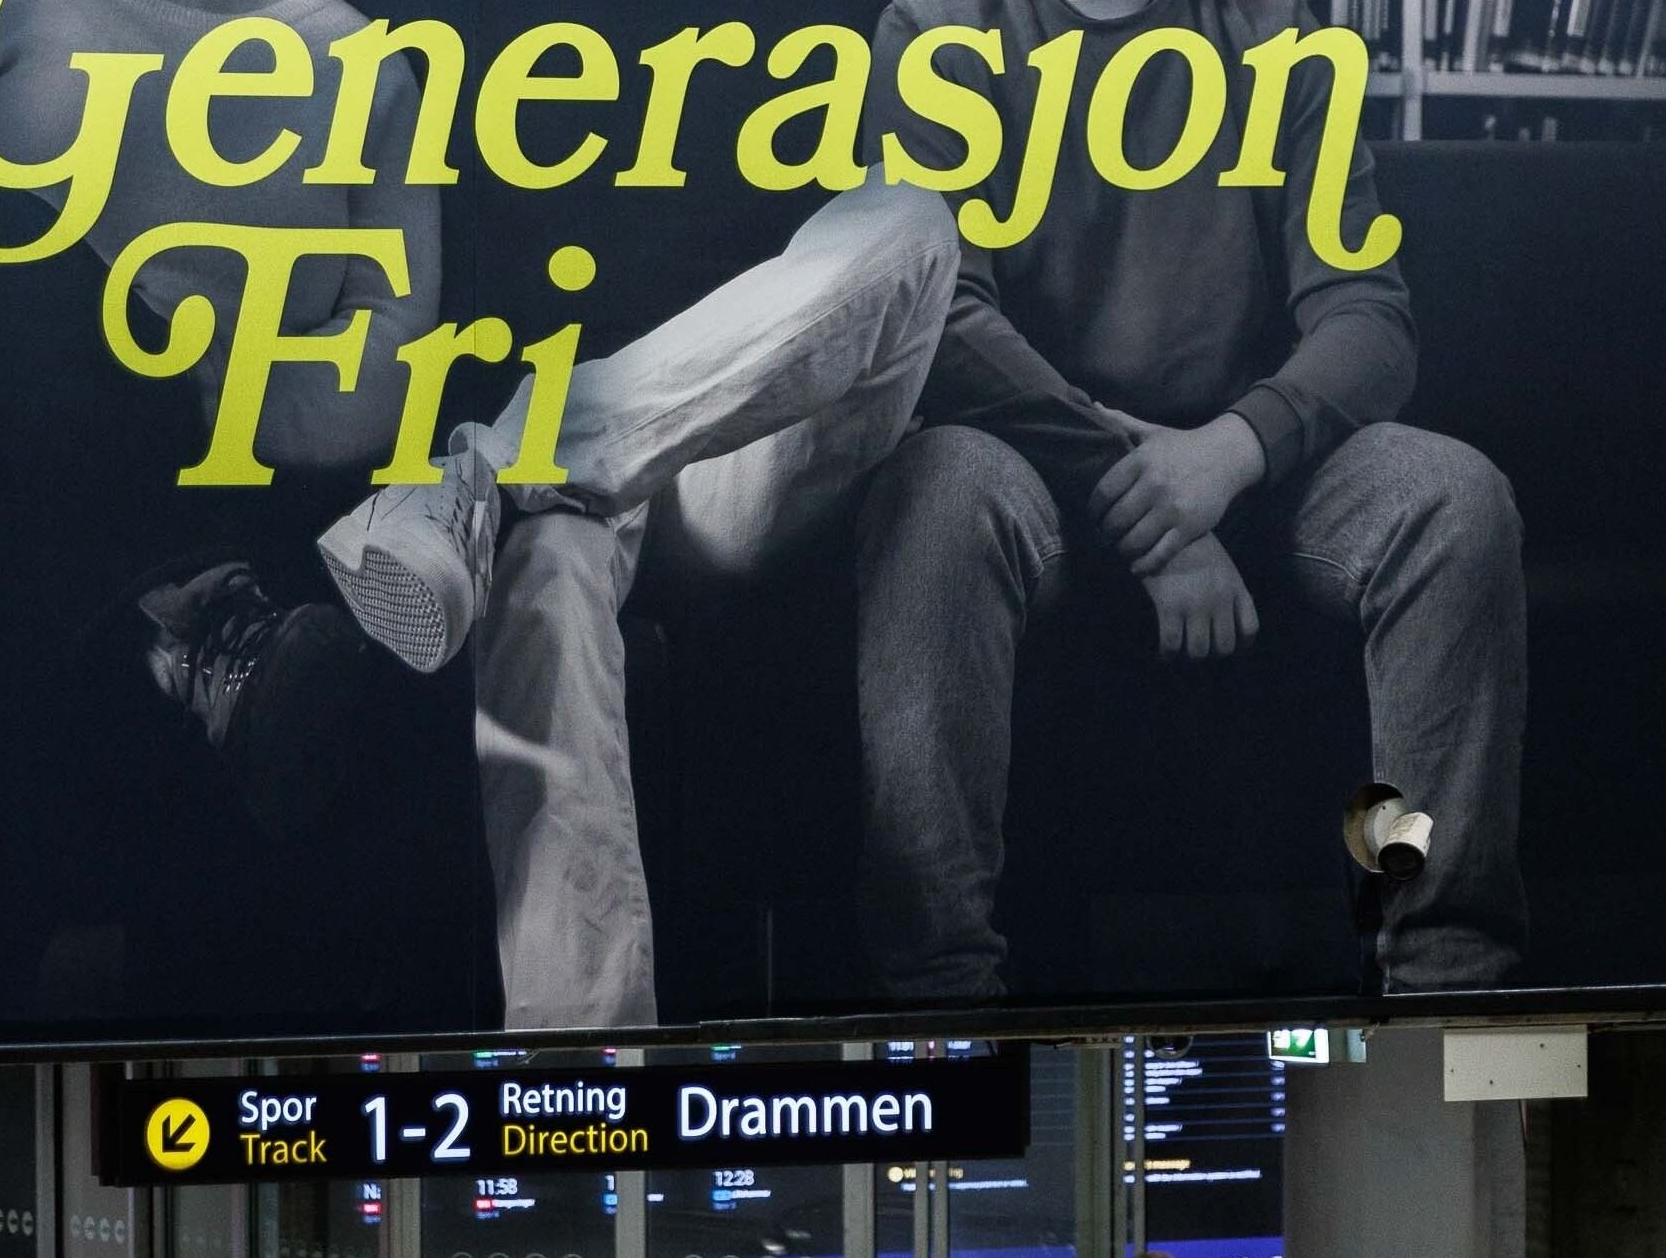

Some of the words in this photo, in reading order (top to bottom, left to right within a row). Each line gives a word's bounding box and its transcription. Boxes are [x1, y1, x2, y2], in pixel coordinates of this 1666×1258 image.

[103, 223, 595, 486] Fri
[240, 1090, 318, 1131] Spor
[501, 1080, 626, 1122] Retning
[679, 1086, 933, 1138] Drammen
[239, 1129, 326, 1164] Track
[364, 1093, 471, 1161] 1-2
[504, 1123, 649, 1155] Direction
